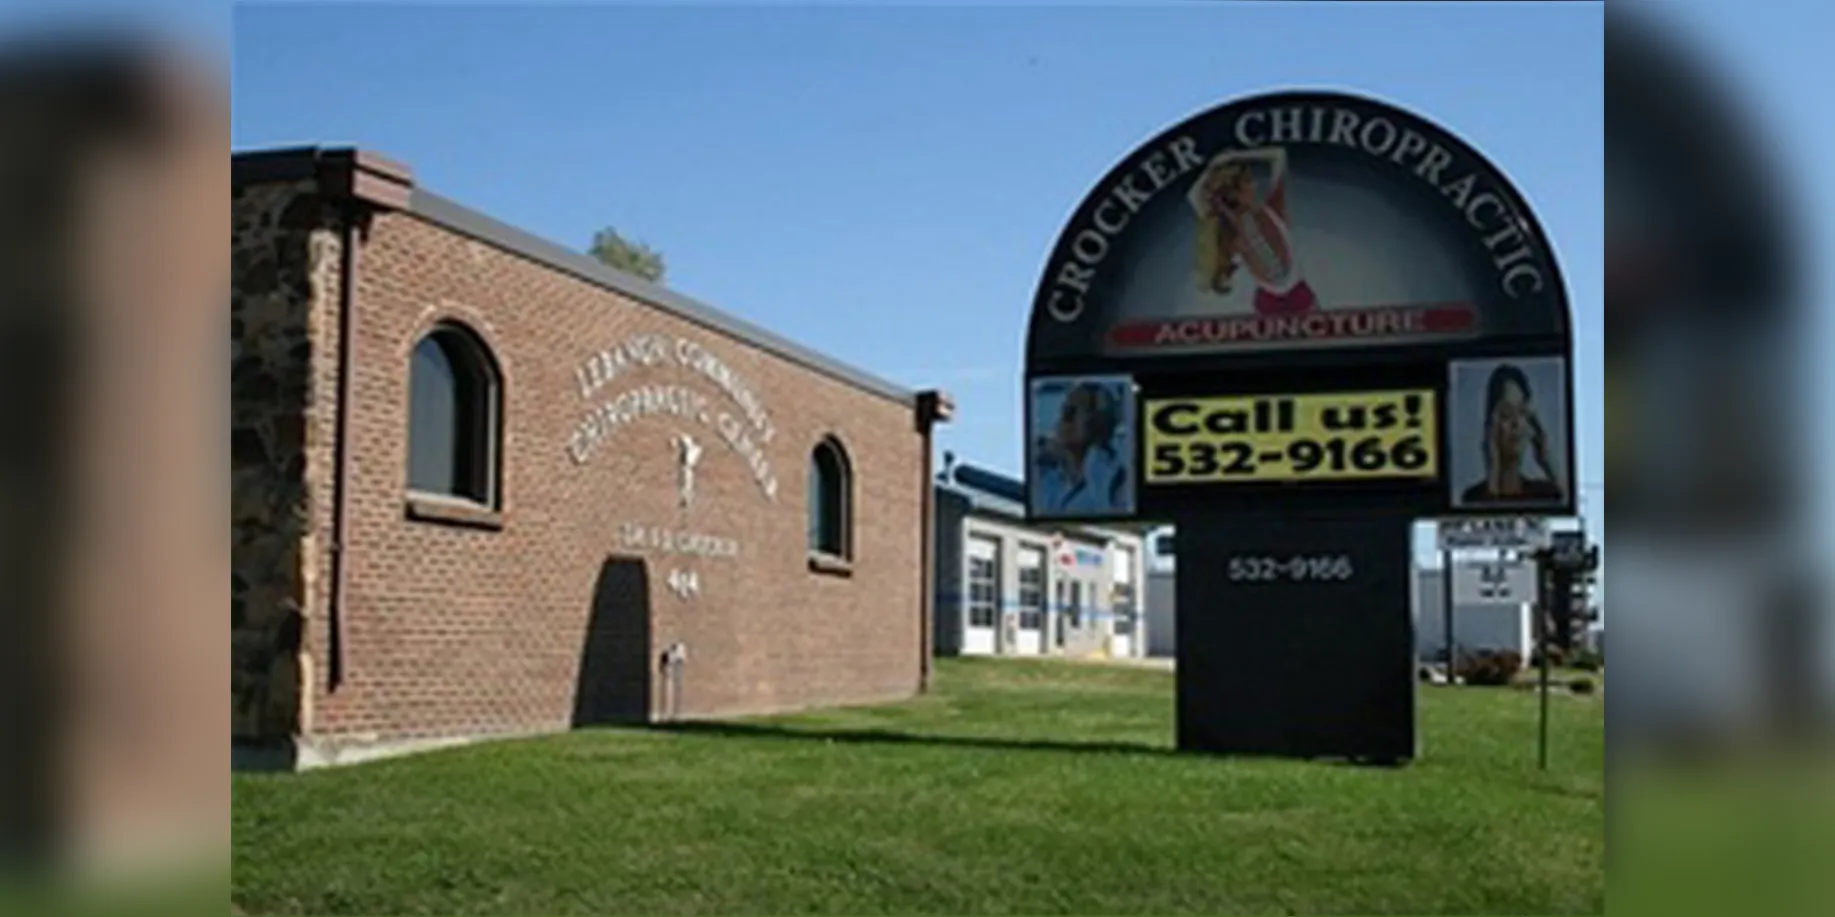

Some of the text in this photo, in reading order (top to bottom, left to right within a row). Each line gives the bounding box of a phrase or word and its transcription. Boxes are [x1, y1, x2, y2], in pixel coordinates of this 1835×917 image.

[1046, 106, 1544, 323] CROCKER CHIROPRACTIC
[1154, 308, 1427, 346] ACUPUNCTURE
[1153, 394, 1422, 436] Call us!
[1152, 434, 1430, 476] 532-9166
[1228, 555, 1353, 581] 532-9166
